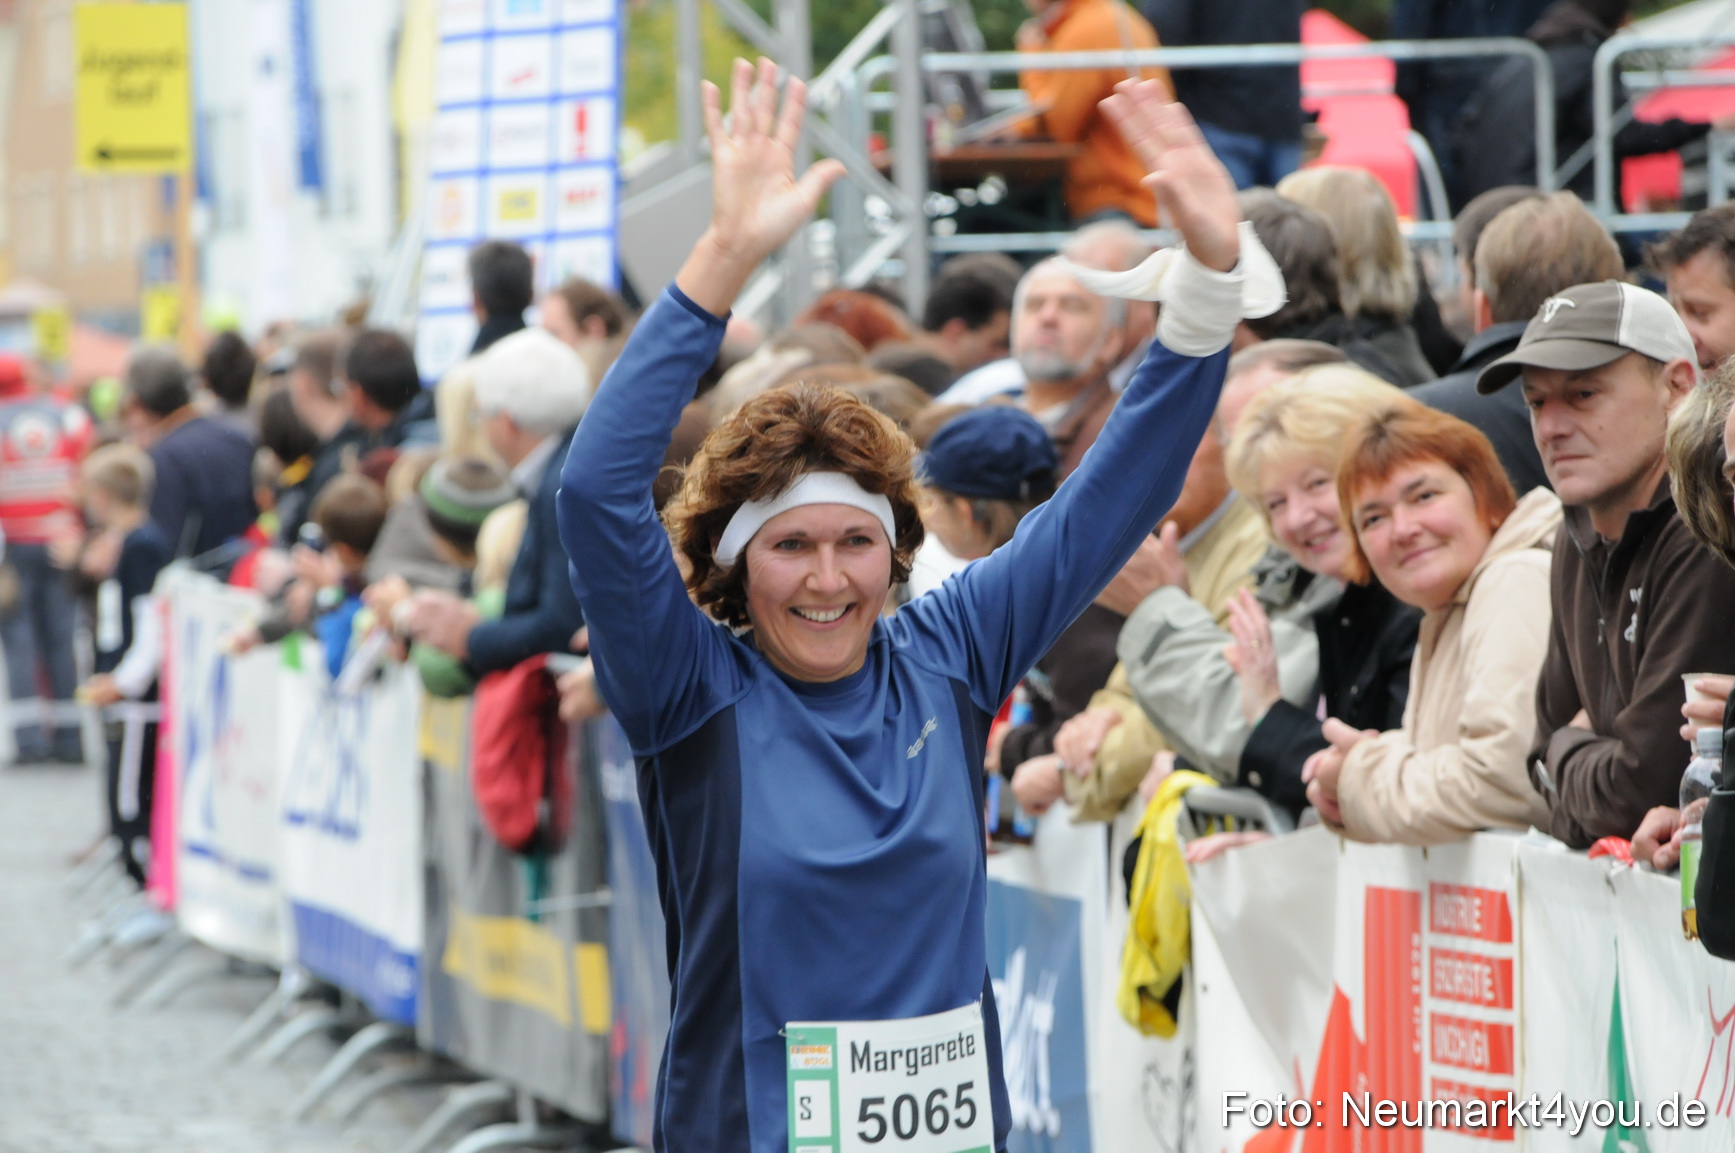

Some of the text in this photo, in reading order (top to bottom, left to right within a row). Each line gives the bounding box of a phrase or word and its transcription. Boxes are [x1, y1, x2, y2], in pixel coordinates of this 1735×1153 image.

[850, 1032, 976, 1077] Margarete
[800, 1096, 812, 1120] S
[857, 1080, 977, 1143] 5065
